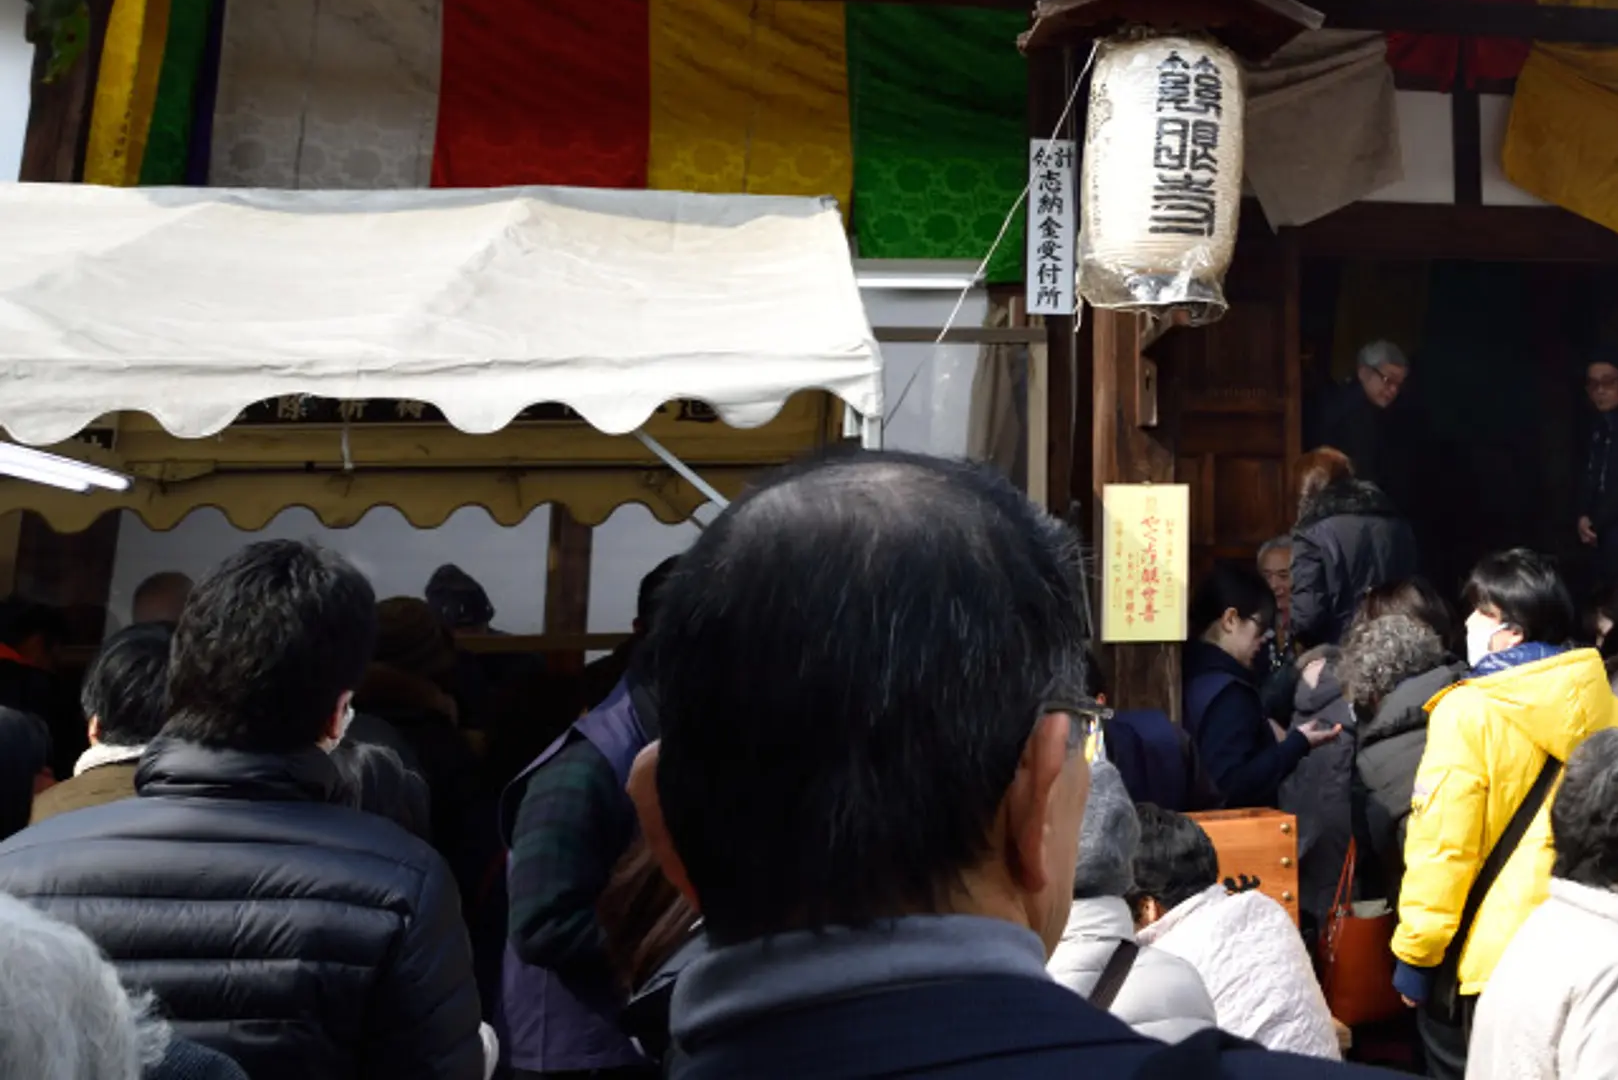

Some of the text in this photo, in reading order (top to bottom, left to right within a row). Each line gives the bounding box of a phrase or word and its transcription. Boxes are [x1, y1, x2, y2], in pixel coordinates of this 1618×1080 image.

[1036, 170, 1064, 309] 志納金受付所
